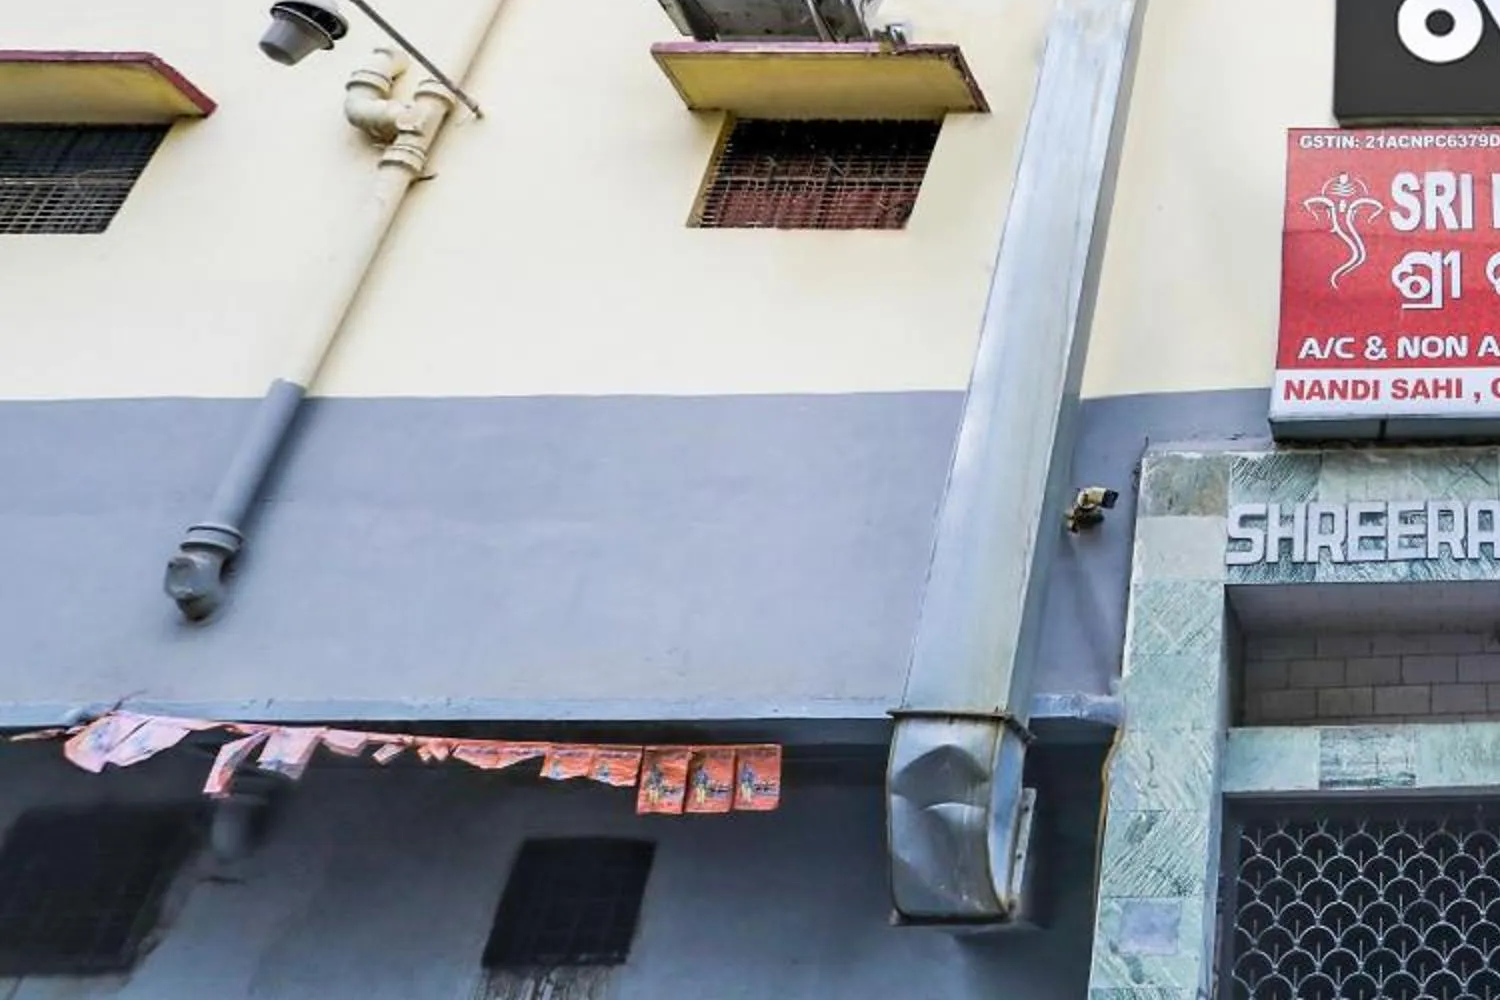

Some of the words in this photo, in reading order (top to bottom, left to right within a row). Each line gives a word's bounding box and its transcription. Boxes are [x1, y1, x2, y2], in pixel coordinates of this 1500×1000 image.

[1299, 135, 1361, 149] GSTIN:
[1389, 171, 1474, 232] SRI
[1298, 336, 1355, 359] A/C
[1364, 336, 1388, 360] &
[1397, 336, 1467, 358] NON
[1283, 378, 1381, 401] NANDI
[1390, 377, 1464, 401] SAHI
